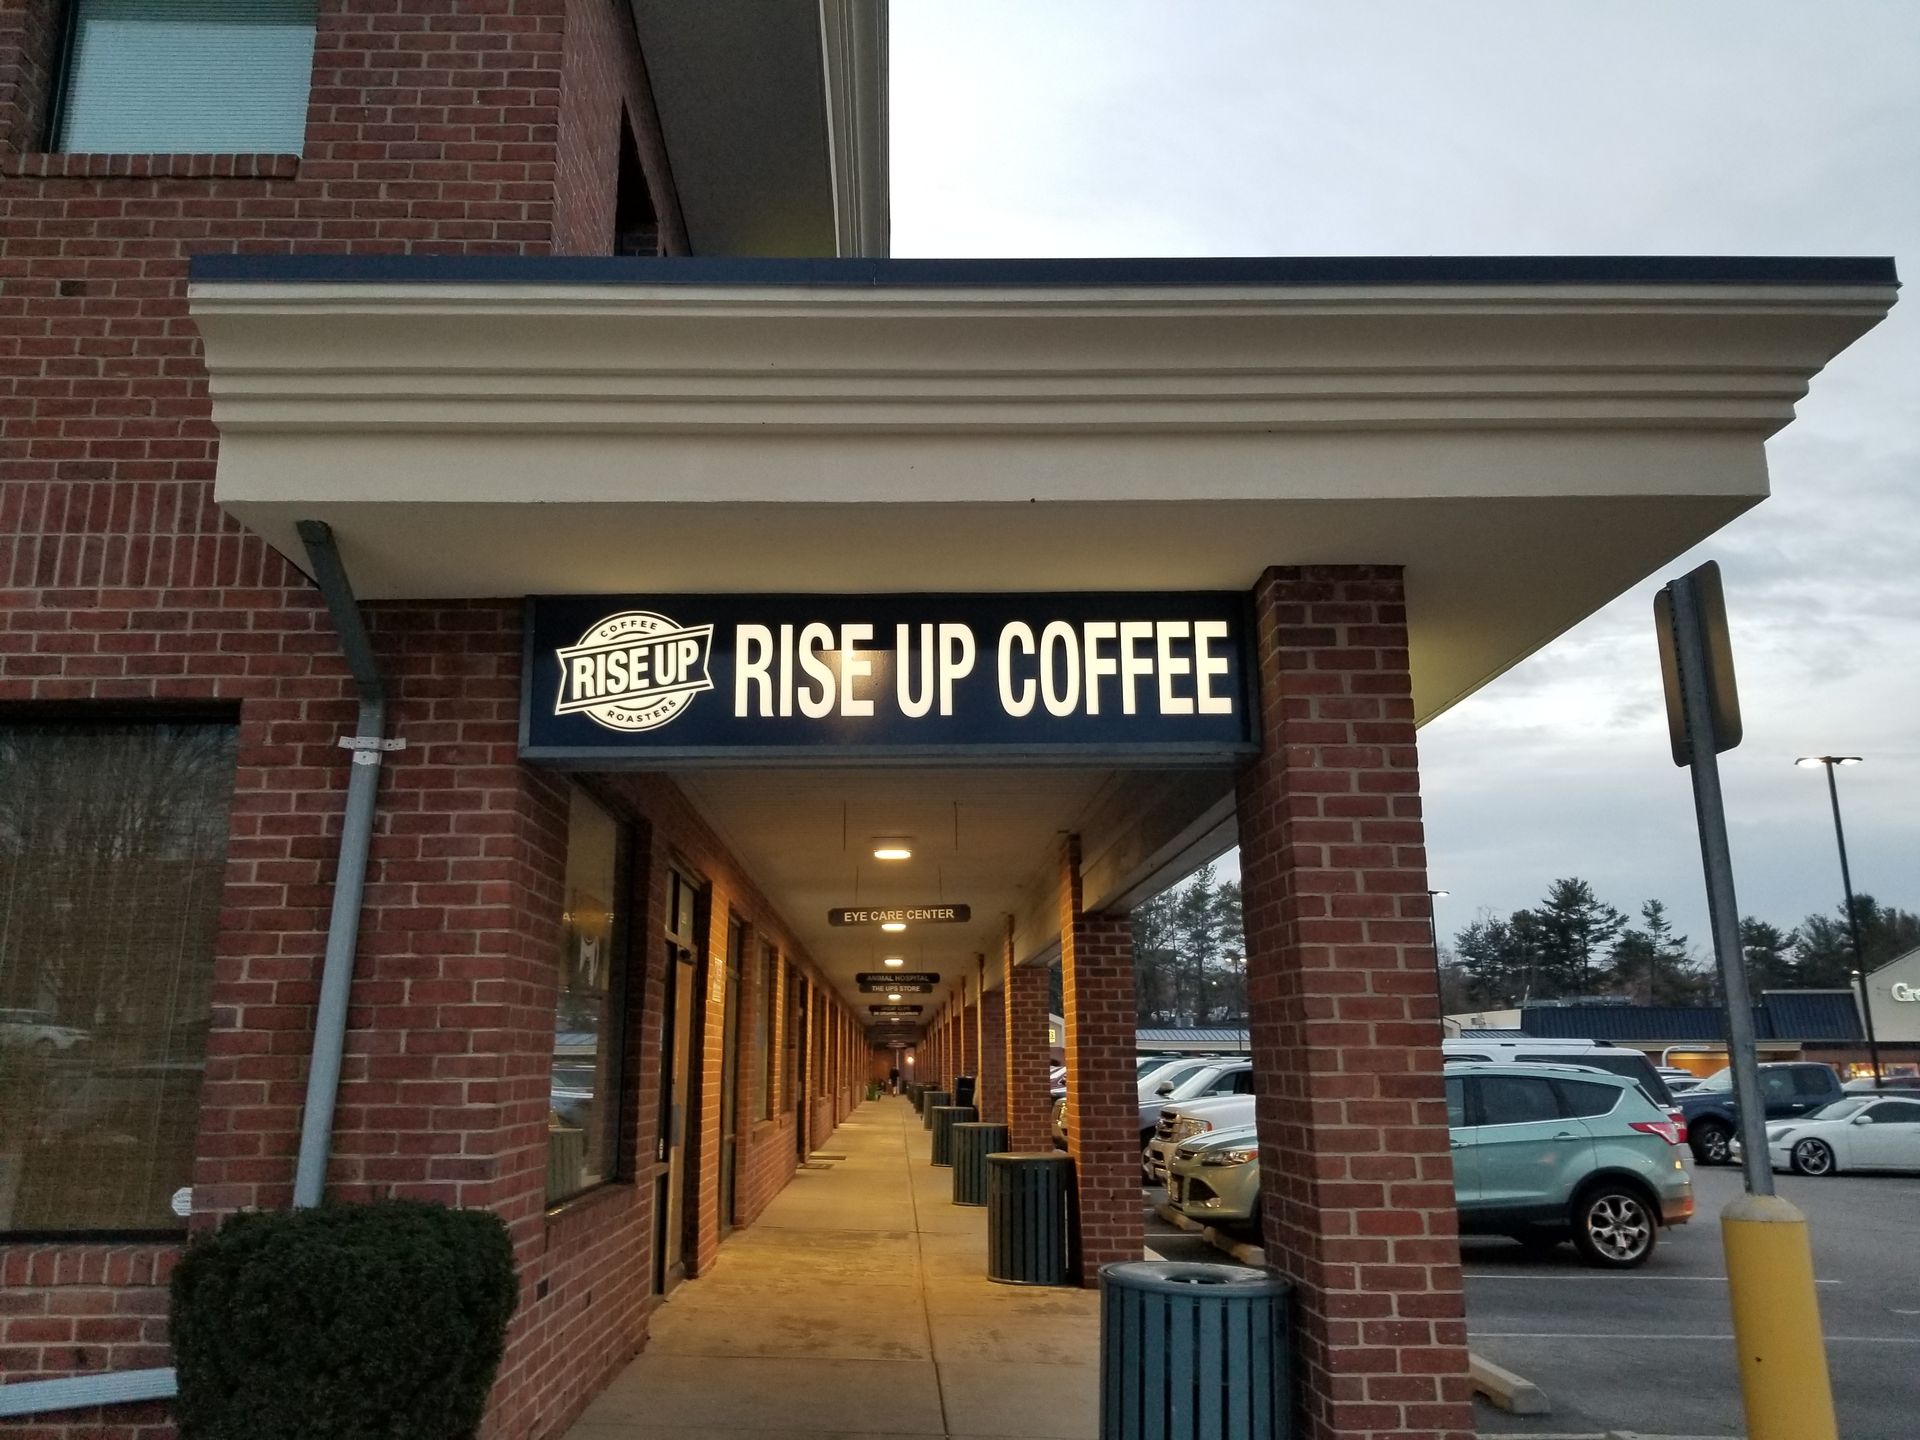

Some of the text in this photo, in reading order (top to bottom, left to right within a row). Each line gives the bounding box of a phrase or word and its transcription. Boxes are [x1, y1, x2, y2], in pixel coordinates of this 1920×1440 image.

[600, 620, 658, 638] COFFEE
[572, 639, 699, 700] RISE UP
[735, 621, 1232, 718] RISE UP COFFEE
[607, 700, 676, 723] ROASTERS
[844, 908, 955, 922] EYE CARE CENTER
